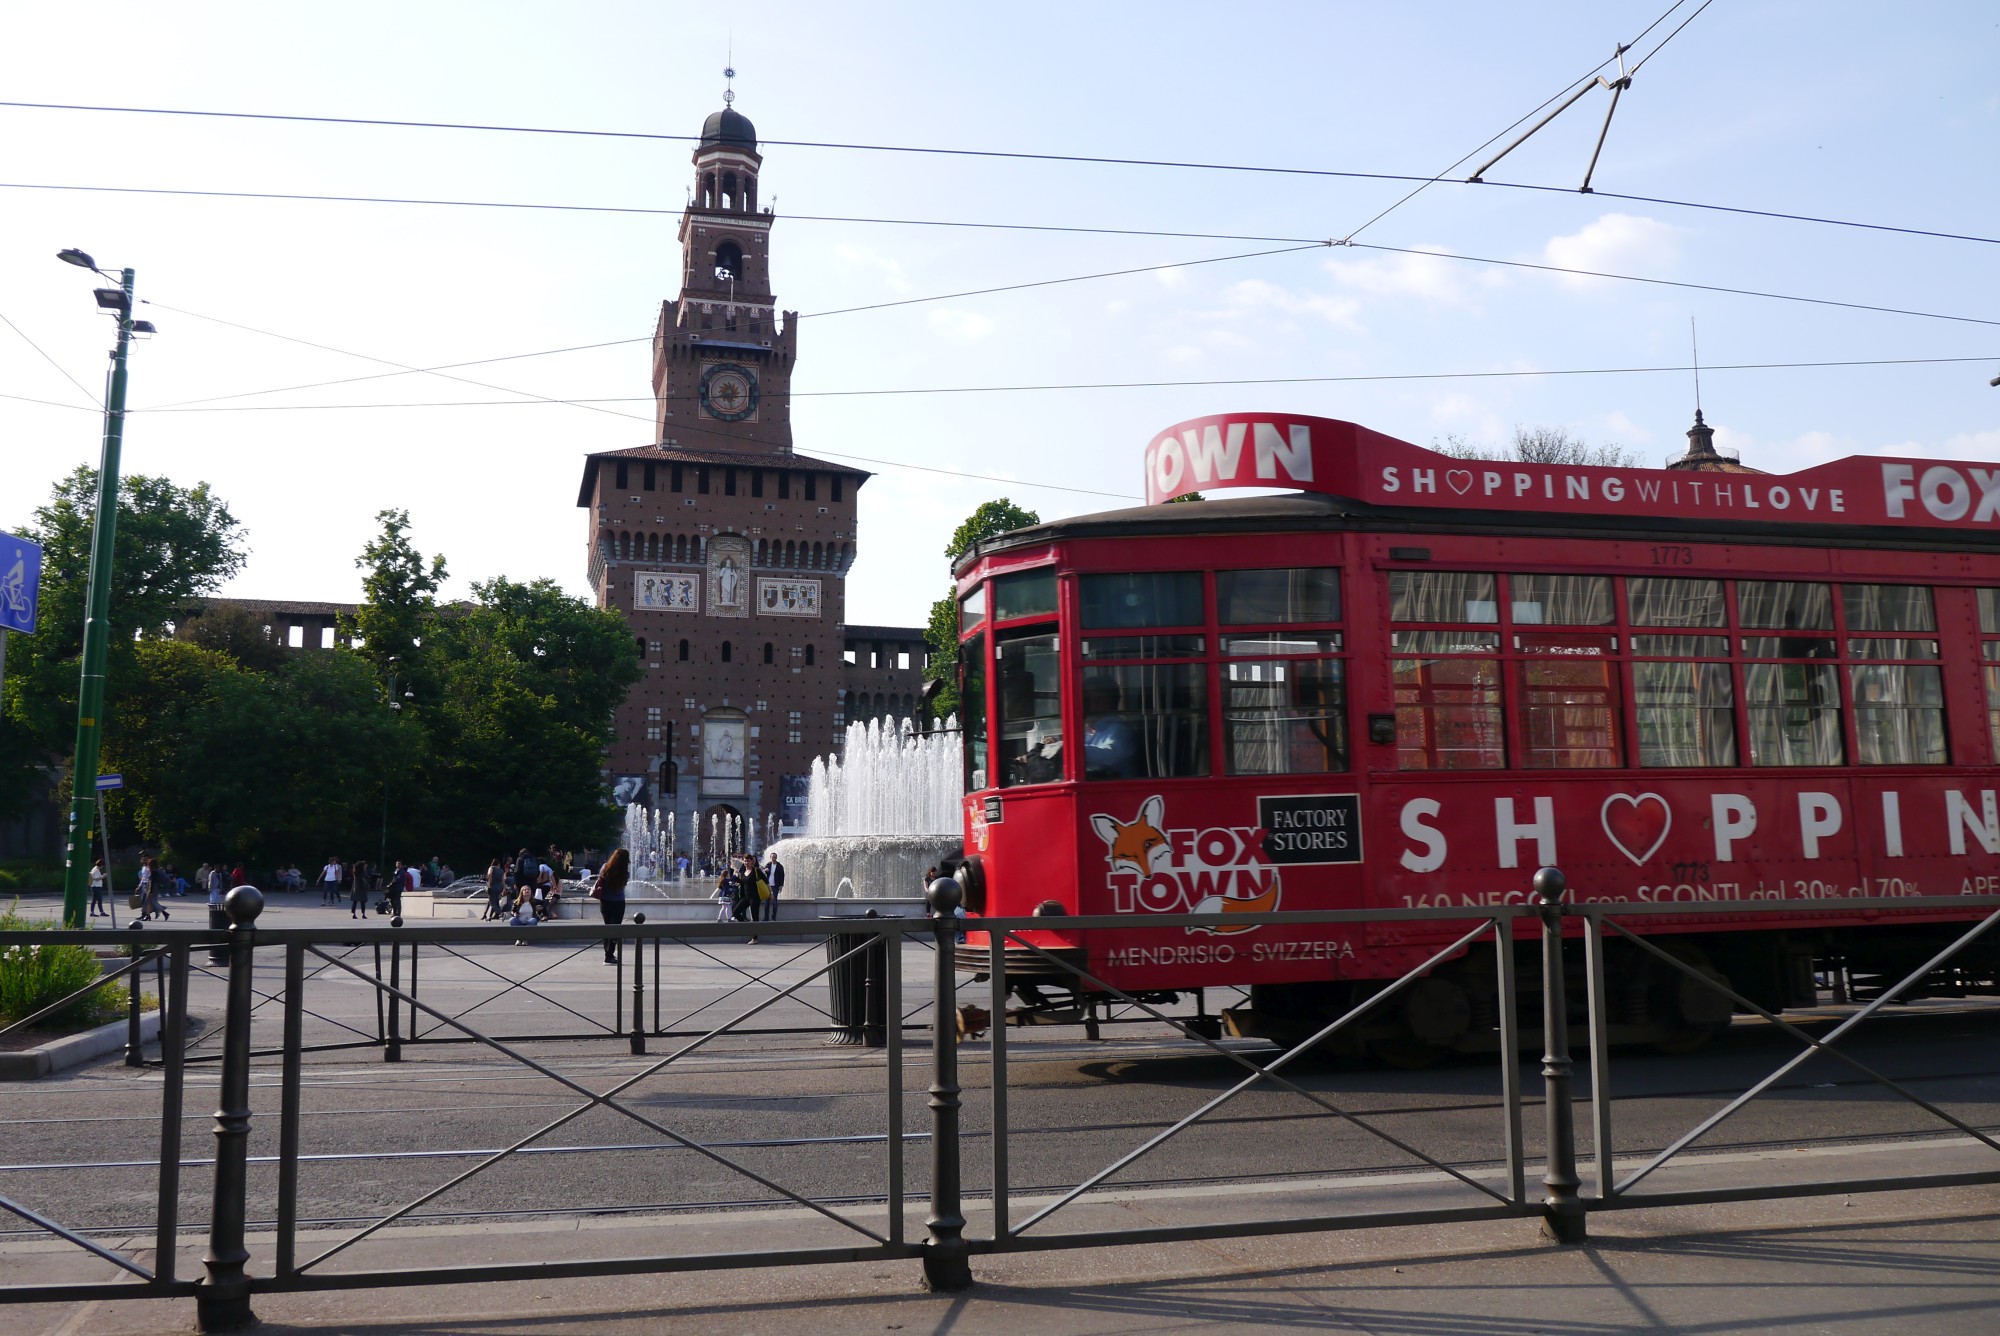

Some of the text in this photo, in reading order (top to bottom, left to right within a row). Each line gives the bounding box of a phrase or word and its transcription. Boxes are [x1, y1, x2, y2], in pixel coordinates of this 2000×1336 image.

[1635, 479, 1733, 506] WITH
[1744, 484, 1845, 512] LOVE
[1882, 462, 2000, 522] FOX
[1651, 546, 1693, 565] 1773
[1273, 809, 1347, 828] FACTORY
[1168, 828, 1273, 868] FOX
[1274, 831, 1348, 850] STORES
[1108, 868, 1275, 912] TOWN
[1637, 883, 1740, 904] SCONTI
[1108, 944, 1236, 967] MENDRISIO
[1252, 940, 1355, 962] SVIZZERA
